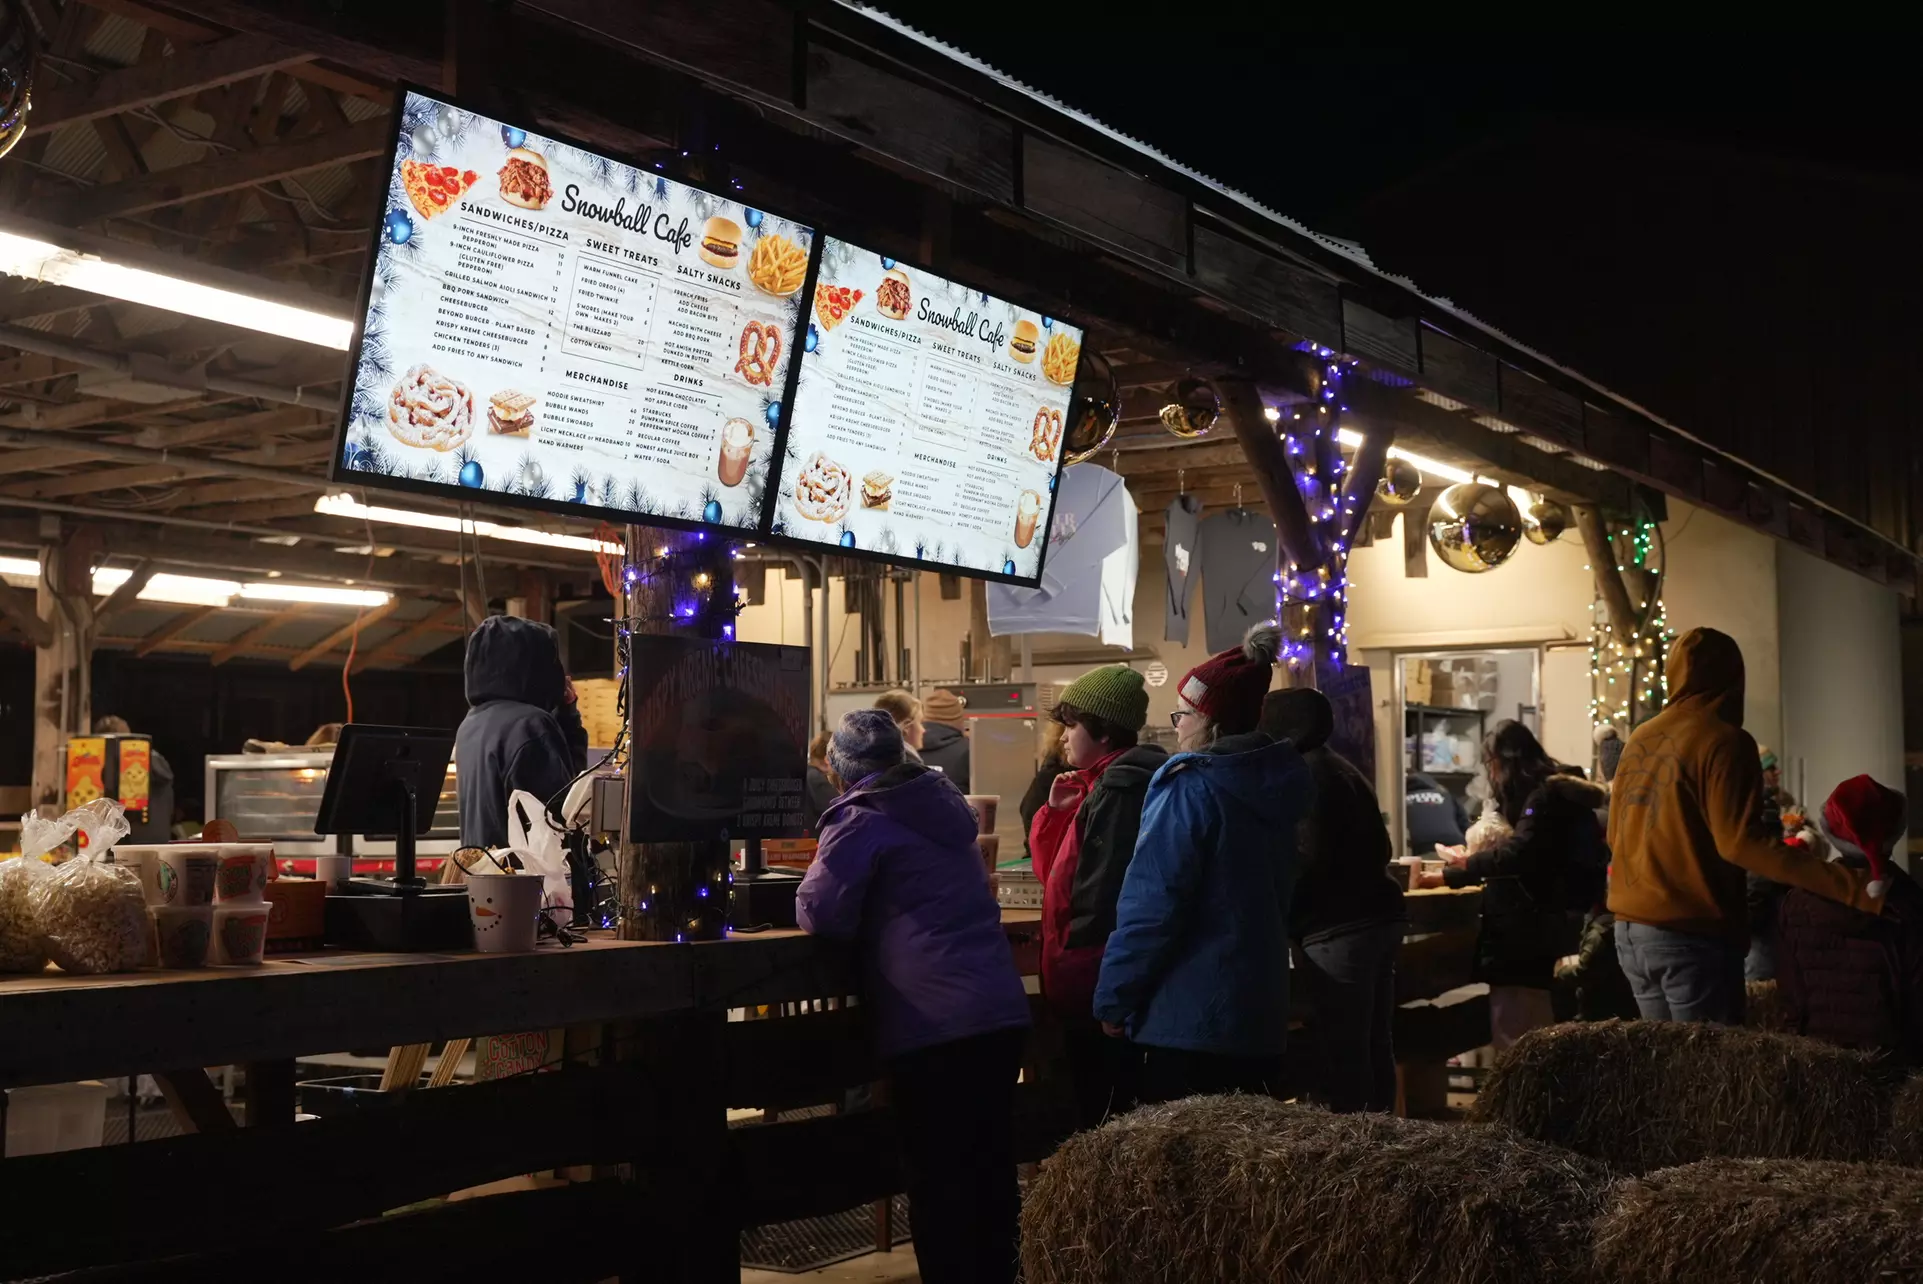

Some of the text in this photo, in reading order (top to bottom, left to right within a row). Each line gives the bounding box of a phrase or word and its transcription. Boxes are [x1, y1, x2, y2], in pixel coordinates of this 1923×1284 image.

[461, 202, 568, 239] SANDWICHES/PIZZA
[562, 184, 691, 254] Snowball Cafe
[462, 234, 497, 248] PEPPERONI
[475, 230, 502, 241] FRESHLY
[503, 238, 520, 247] MADE
[522, 242, 539, 252] PIZZA
[472, 247, 515, 263] CAULIFLOWER
[517, 259, 534, 268] PIZZA
[586, 238, 658, 266] SWEET TREATS
[457, 261, 492, 274] PEPPERONI
[583, 265, 601, 273] WARM
[602, 269, 622, 279] FUNNEL
[624, 275, 638, 284] CAKE
[444, 270, 470, 281] GRILLED
[472, 277, 497, 288] SALMON
[517, 288, 548, 300] SANDWICH
[581, 277, 597, 285] FRIED
[598, 281, 616, 291] OREOS
[677, 265, 740, 290] SALTY SNACKS
[442, 283, 456, 293] BBQ
[457, 287, 474, 296] PORK
[476, 292, 509, 304] SANDWICH
[578, 288, 594, 297] FRIED
[673, 289, 693, 298] FRENCH
[440, 295, 488, 311] CHEESEBURGER
[678, 299, 709, 312] ADD CHEESE
[437, 307, 463, 318] BEYOND
[465, 314, 489, 324] BURGER
[495, 321, 514, 329] PLANT
[515, 326, 535, 335] BASED
[575, 310, 589, 318] OWN
[593, 315, 612, 324] MAKES
[619, 313, 634, 321] YOUR
[917, 297, 1004, 352] Snowball Cafe
[435, 320, 528, 345] KRISPY KREME CHEESEBURGER
[584, 326, 611, 337] BLIZZARD
[668, 320, 689, 329] NACHOS
[703, 329, 722, 338] CHEESE
[850, 315, 921, 343] SANDWICHES/PIZZA
[433, 331, 500, 352] CHICKEN TENDERS (3)
[570, 337, 612, 351] COTTON CANDY
[685, 332, 696, 340] BBQ
[696, 335, 710, 343] PORK
[431, 343, 446, 351] ADD
[490, 356, 522, 367] SANDWICH
[663, 347, 684, 357] DUNKED
[691, 354, 709, 363] BUTTER
[676, 344, 692, 352] AMISH
[692, 347, 712, 357] PRETZEL
[932, 342, 980, 363] SWEET TREATS
[993, 361, 1036, 381] SALTY SNACKS
[565, 370, 628, 390] MERCHANDISE
[673, 374, 703, 386] DRINKS
[547, 391, 569, 399] HOODIE
[570, 395, 604, 406] SWEATSHIRT
[657, 389, 674, 397] EXTRA
[674, 393, 706, 404] CHOCOLATEY
[545, 401, 566, 410] BUBBLE
[568, 406, 588, 414] WANDS
[642, 407, 671, 418] STARBUCKS
[673, 402, 688, 410] CIDER
[543, 413, 565, 422] BUBBLE
[641, 414, 698, 431] PUMPKIN SPICE COFFEE
[558, 430, 586, 439] NECKLACE
[594, 436, 624, 446] HEADBAND
[637, 432, 680, 445] REGULAR COFFEE
[672, 428, 690, 436] MOCHA
[690, 432, 709, 440] COFFEE
[538, 438, 554, 446] HAND
[556, 442, 583, 451] WARMERS
[914, 453, 956, 468] MERCHANDISE
[987, 453, 1007, 464] DRINKS
